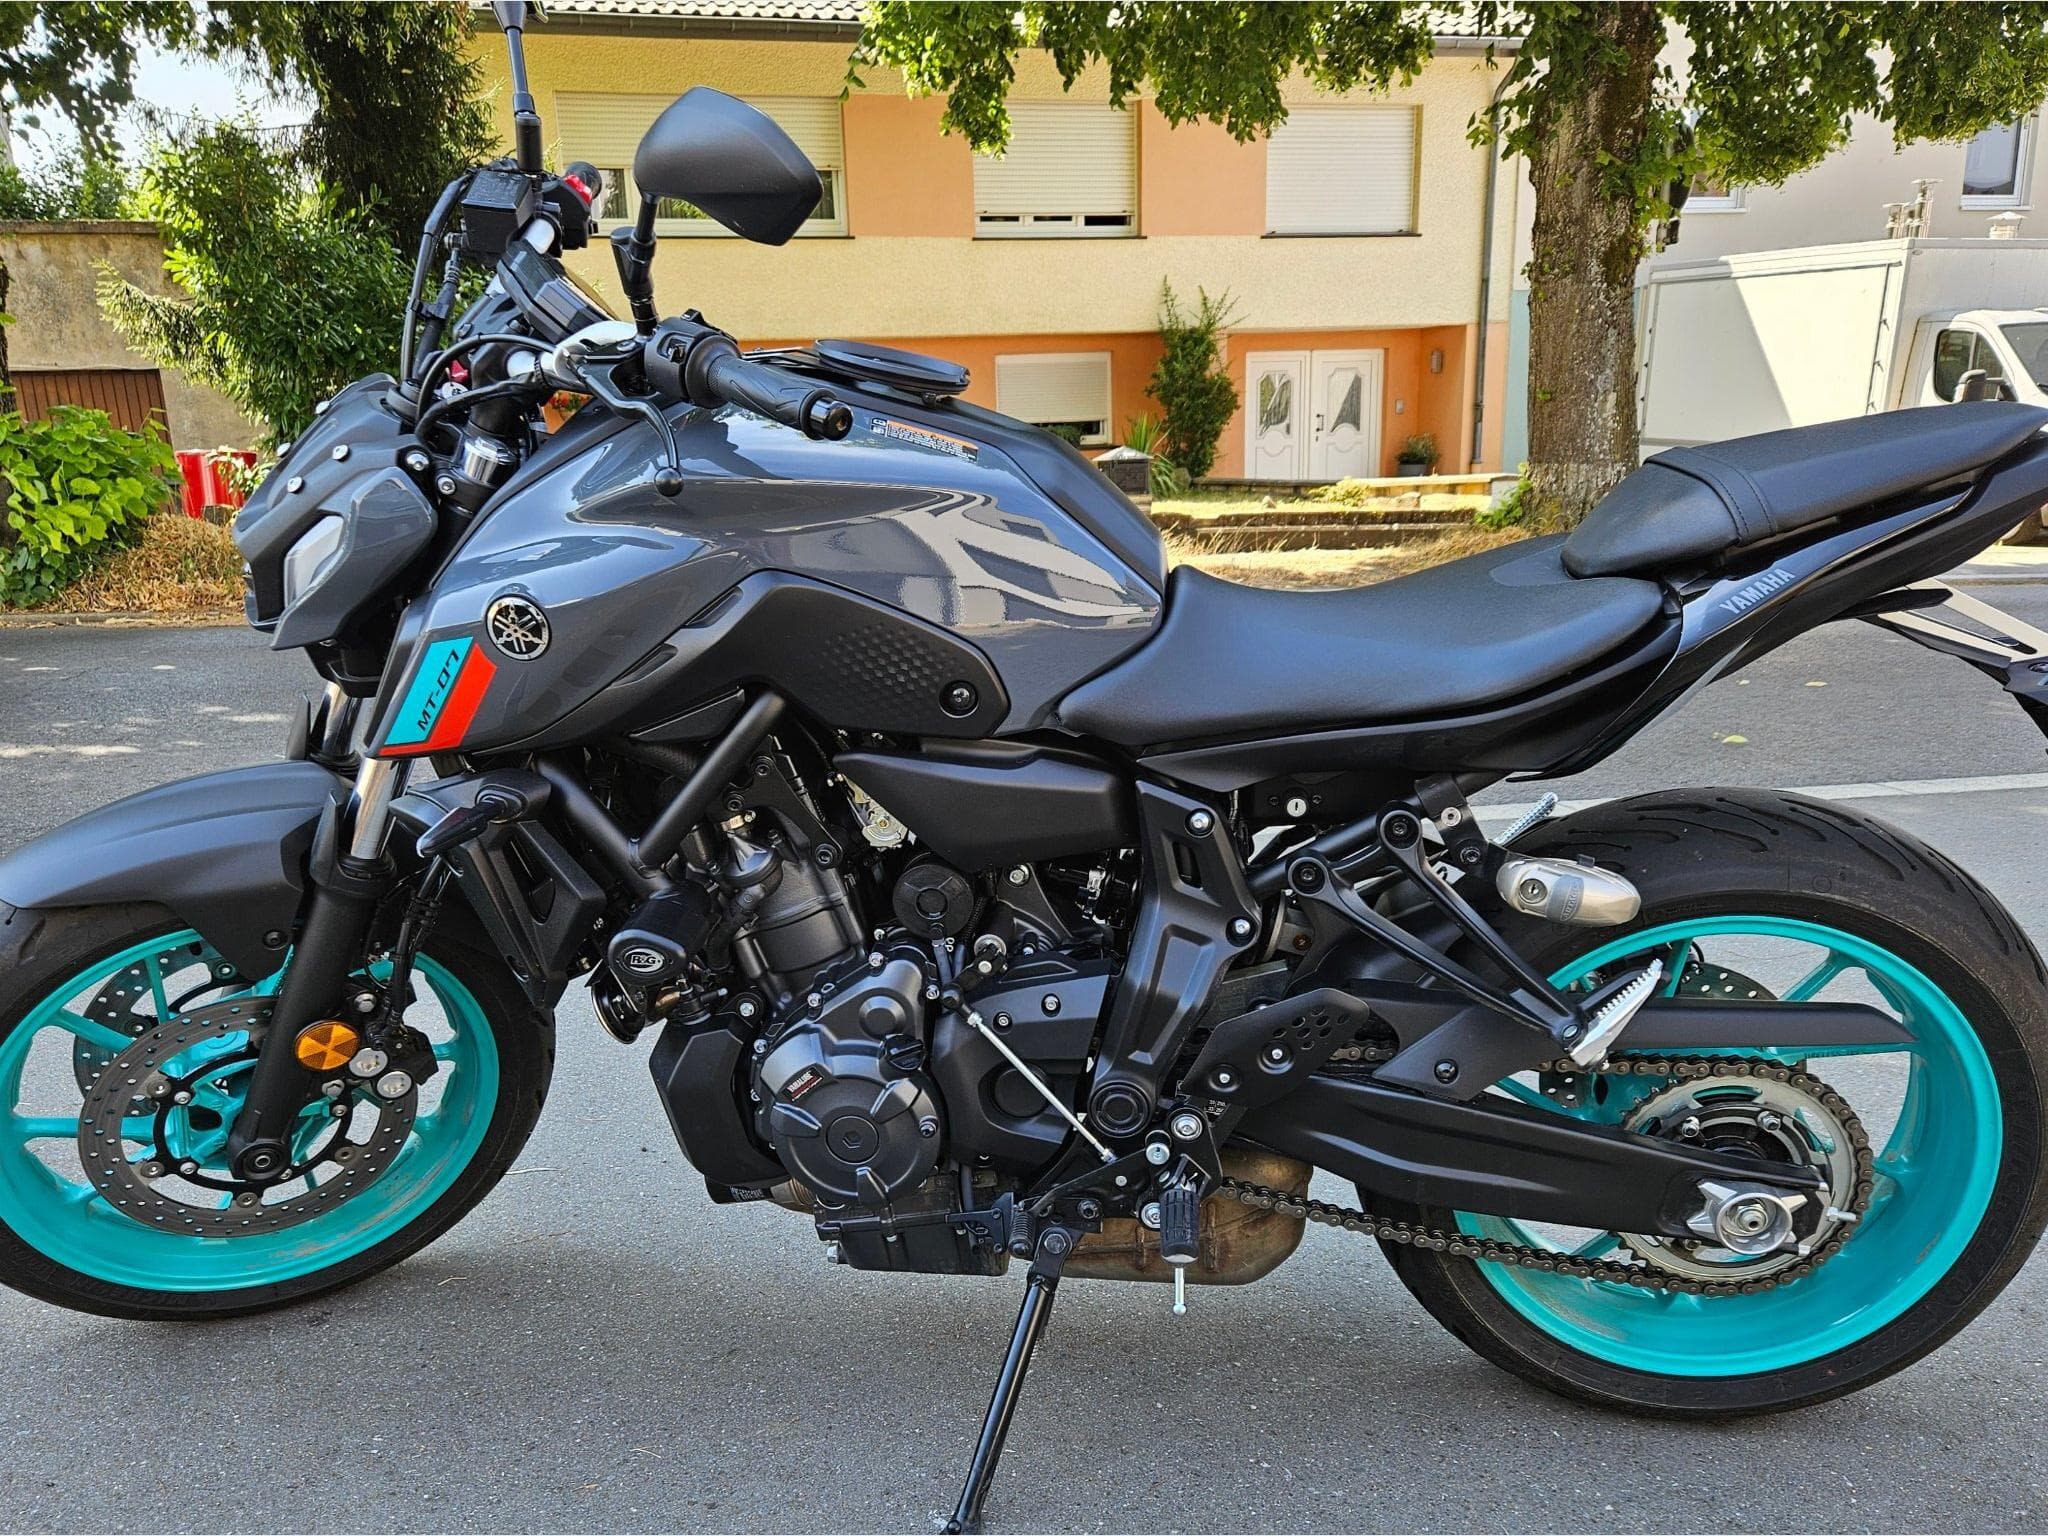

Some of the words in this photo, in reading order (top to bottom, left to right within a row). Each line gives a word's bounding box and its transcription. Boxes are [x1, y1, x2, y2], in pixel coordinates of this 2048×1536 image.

[1719, 568, 1796, 614] YAMAHA
[417, 649, 459, 731] MT-07
[631, 954, 657, 965] R&G
